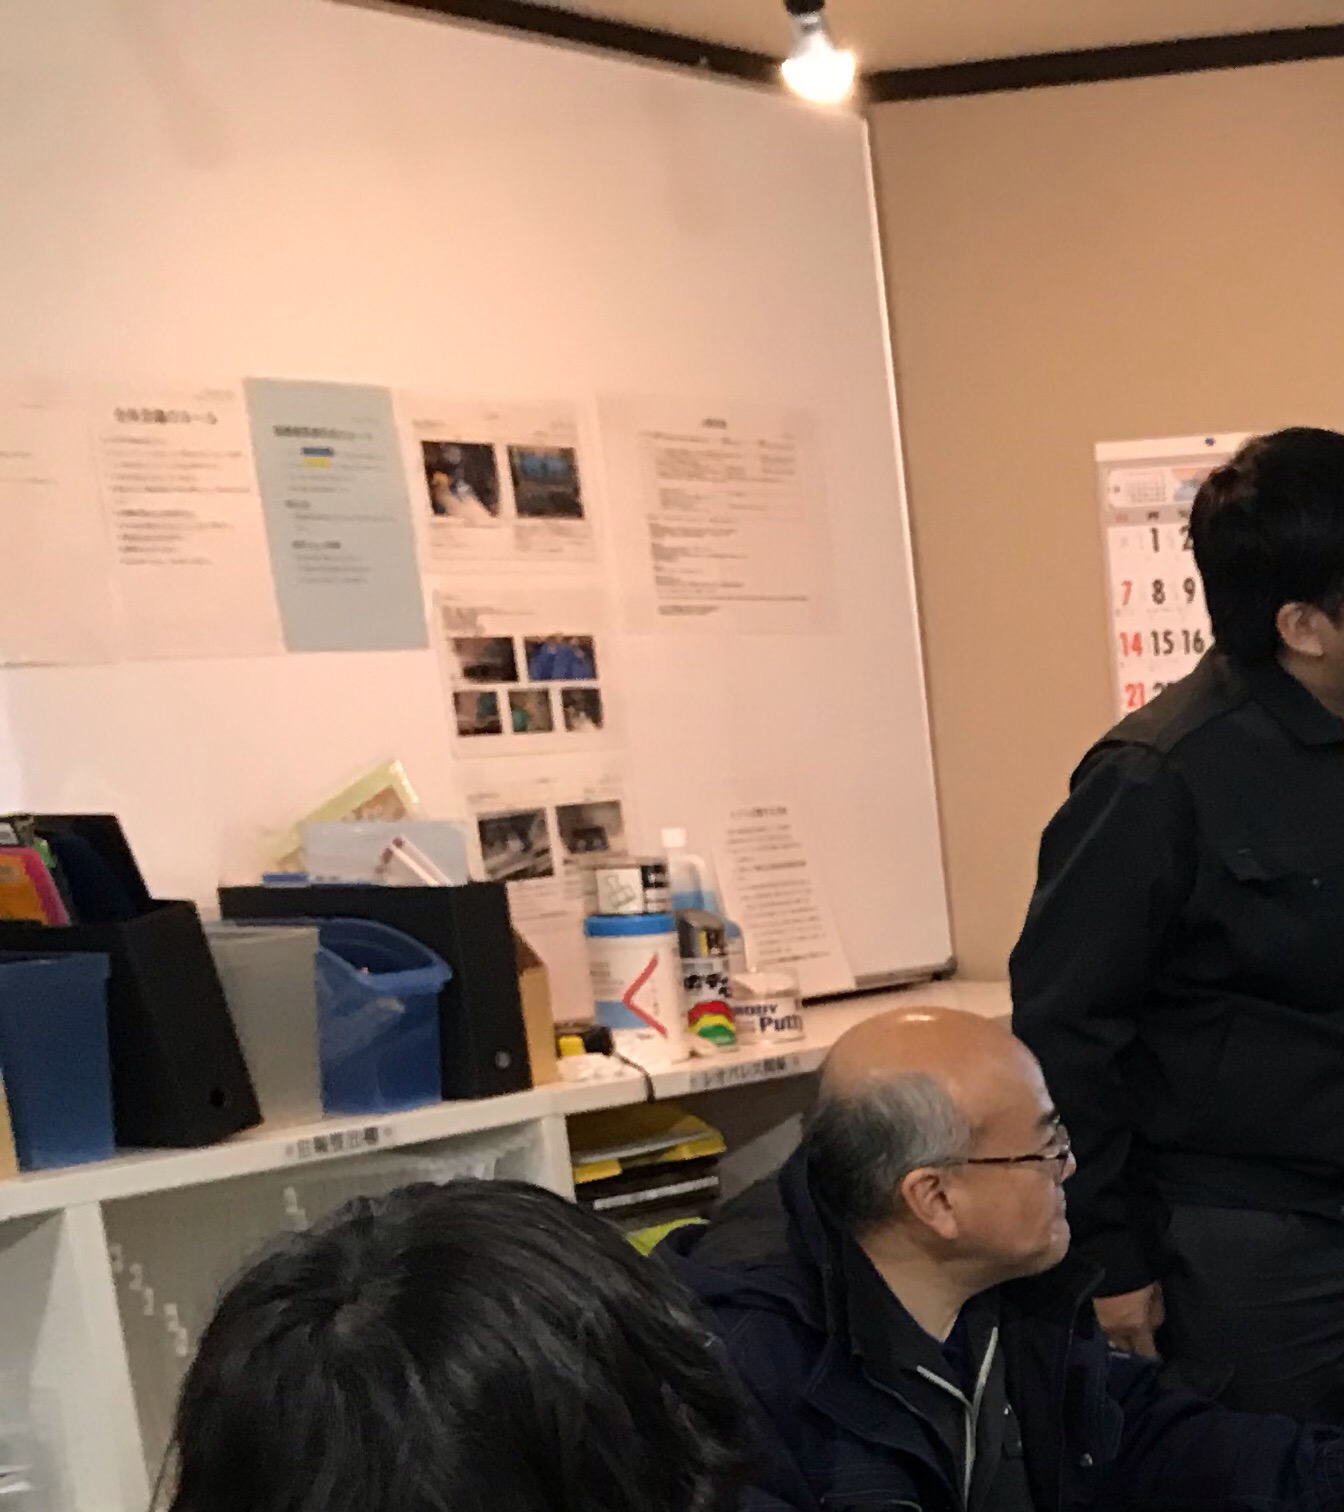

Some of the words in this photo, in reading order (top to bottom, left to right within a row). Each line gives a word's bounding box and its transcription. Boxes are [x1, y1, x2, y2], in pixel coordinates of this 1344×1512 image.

[1150, 527, 1160, 553] 1
[1121, 580, 1134, 606] 7
[1151, 579, 1166, 605] 8
[1182, 577, 1196, 604] 9
[1119, 632, 1143, 657] 14
[1150, 630, 1174, 657] 15
[1181, 629, 1205, 656] 16
[1125, 682, 1146, 708] 21
